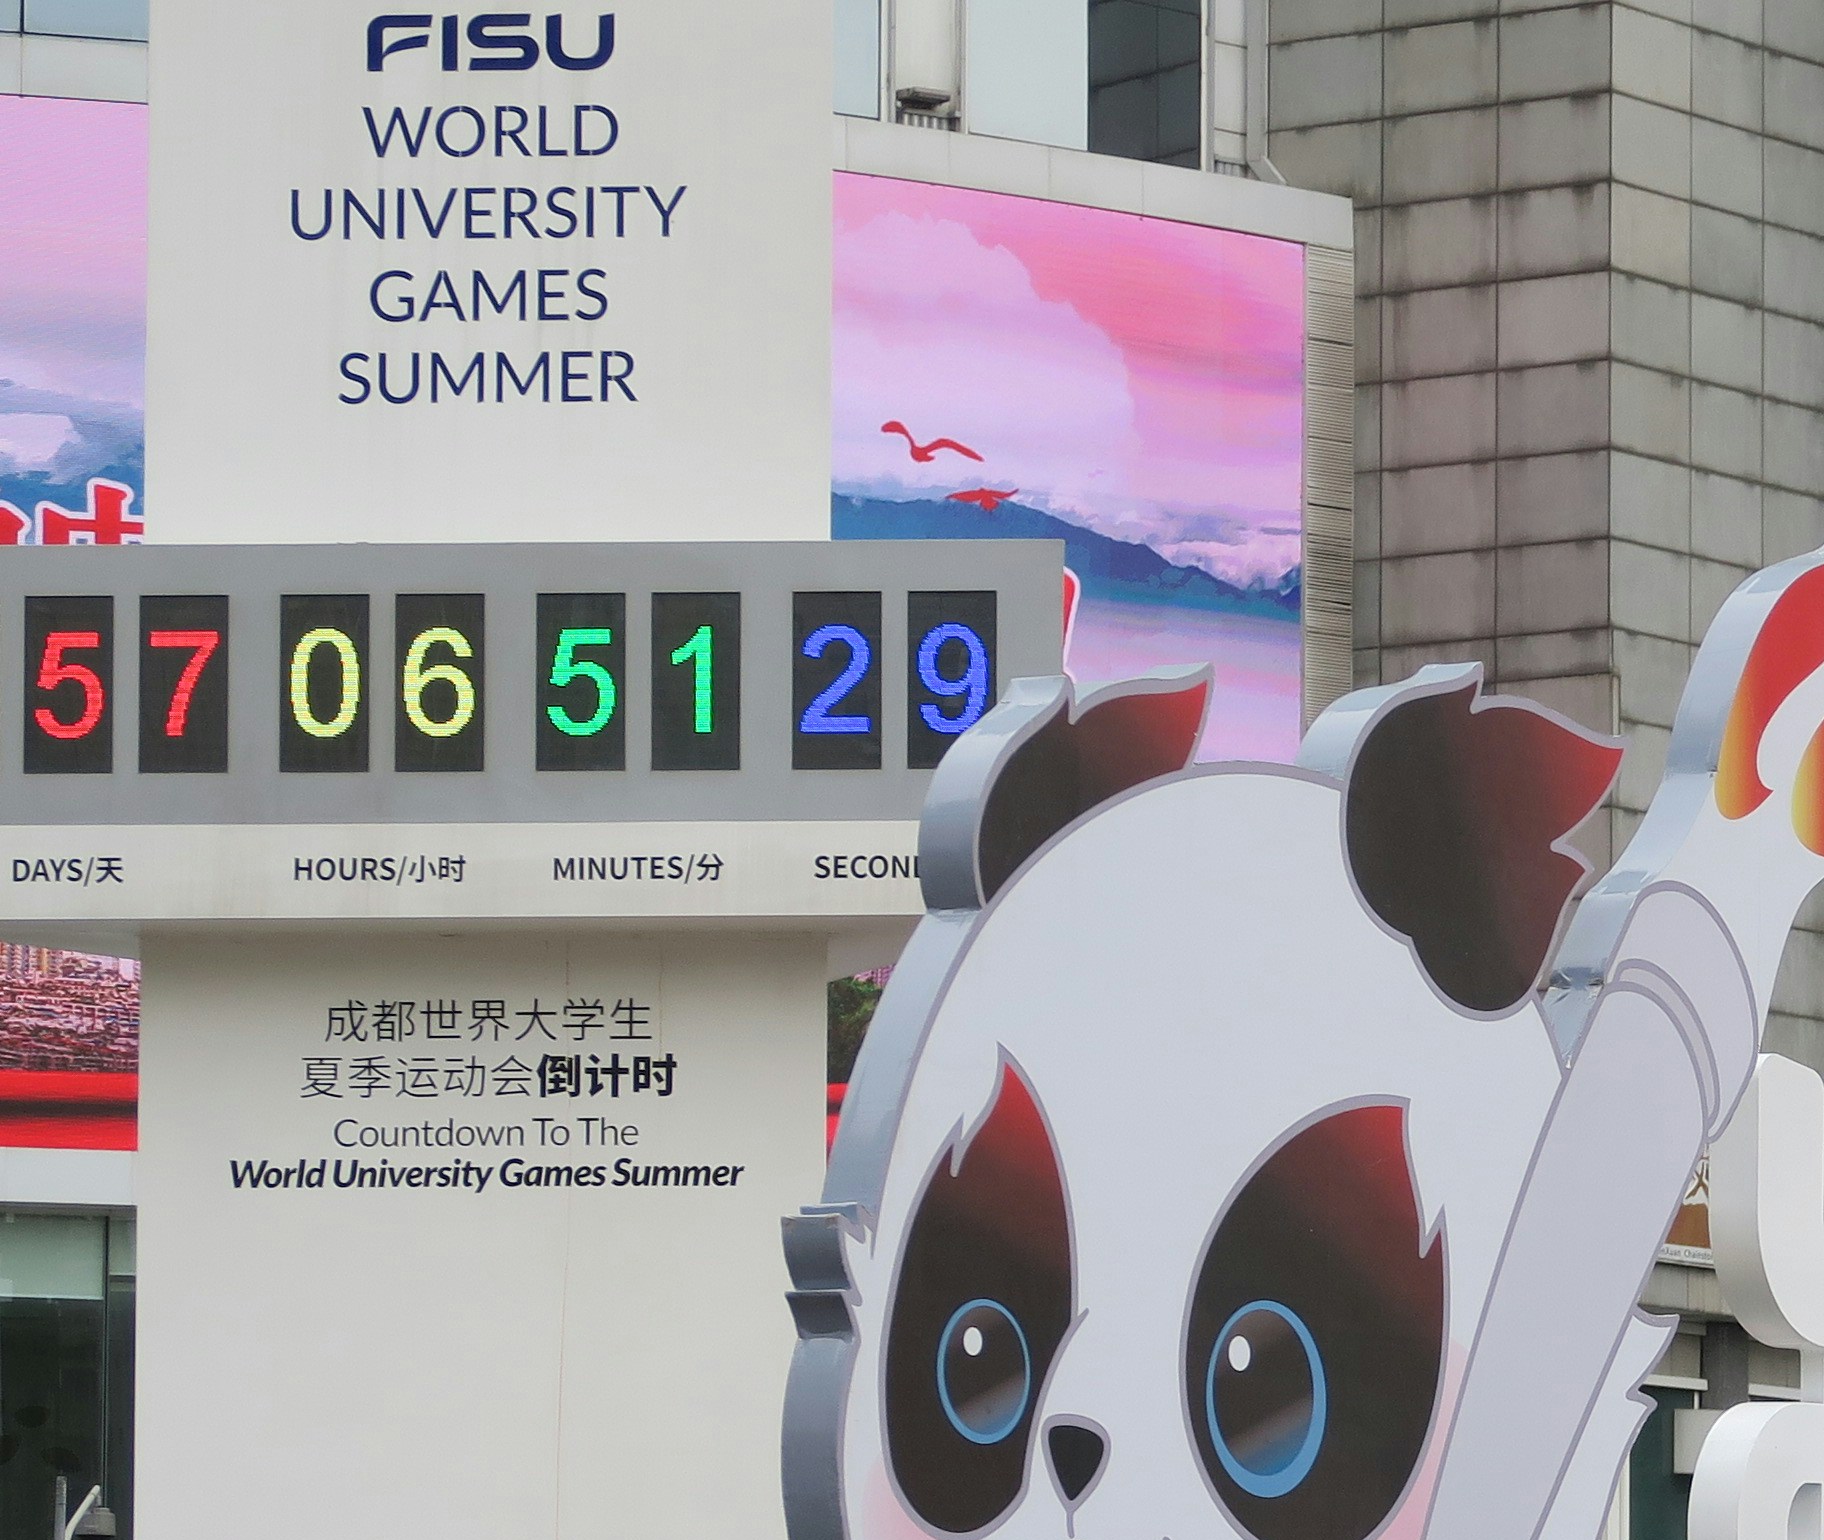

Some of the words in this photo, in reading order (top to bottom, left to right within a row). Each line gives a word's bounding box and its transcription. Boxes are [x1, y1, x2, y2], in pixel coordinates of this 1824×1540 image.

[366, 13, 615, 72] FISU
[362, 104, 619, 158] WORLD
[290, 185, 687, 241] UNIVERSITY
[369, 268, 608, 323] GAMES
[338, 350, 638, 405] SUMMER
[289, 627, 476, 737] 06
[545, 625, 715, 737] 51
[11, 856, 124, 885] DAYS/天
[293, 855, 467, 886] HOURS/小时
[552, 853, 725, 884] MINUTES/分
[814, 855, 921, 879] SECON
[324, 997, 653, 1043] 成都世界大学生
[299, 1052, 678, 1099] 夏季运动会倒计时
[332, 1117, 525, 1148] Countdown
[531, 1117, 571, 1147] To
[577, 1116, 640, 1146] The
[229, 1158, 326, 1189] World
[332, 1158, 494, 1194] University
[499, 1158, 607, 1188] Games
[611, 1157, 746, 1188] Summer
